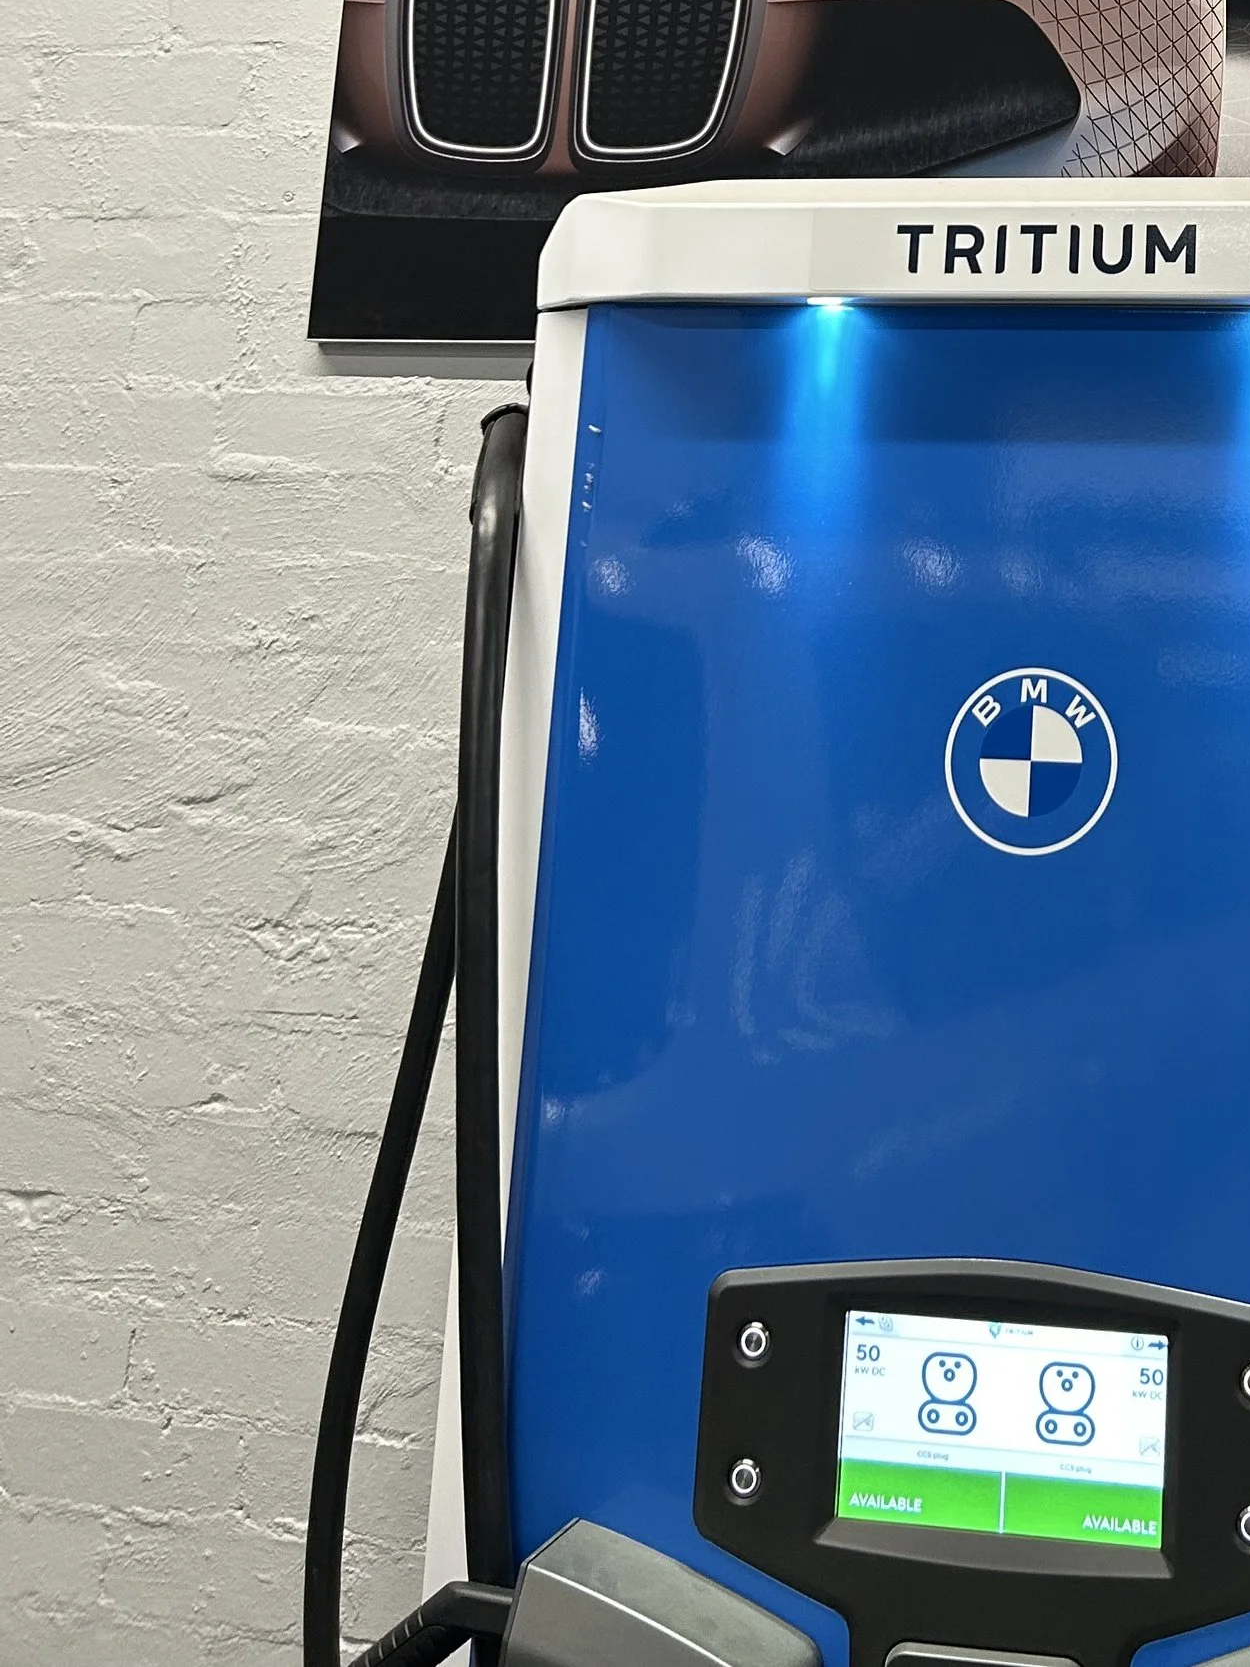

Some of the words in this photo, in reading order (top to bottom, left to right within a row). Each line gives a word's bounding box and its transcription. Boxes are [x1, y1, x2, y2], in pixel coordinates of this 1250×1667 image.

[897, 224, 1198, 275] TRITIUM
[971, 677, 1097, 729] BMW
[856, 1344, 881, 1362] 50
[871, 1367, 887, 1376] DC
[1139, 1367, 1164, 1386] 50
[849, 1491, 923, 1514] AVAILABLE
[1082, 1514, 1158, 1535] AVAILABLE
